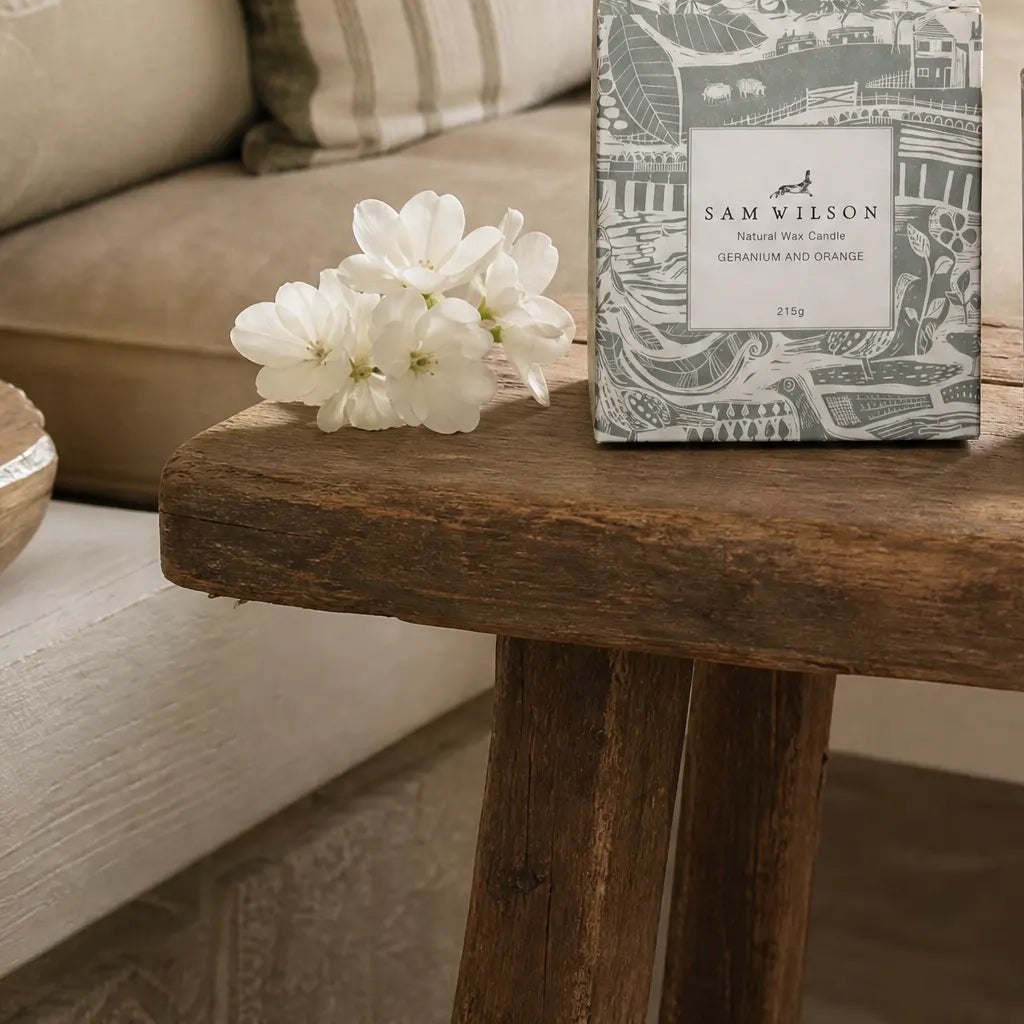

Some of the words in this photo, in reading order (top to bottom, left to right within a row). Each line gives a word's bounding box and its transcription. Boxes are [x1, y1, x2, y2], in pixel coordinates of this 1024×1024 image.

[704, 206, 758, 221] SAM
[771, 205, 877, 220] WILSON
[737, 231, 777, 241] Natural
[780, 231, 804, 241] Wax
[808, 230, 846, 241] Candle
[717, 252, 781, 262] GERANIUM
[784, 251, 810, 262] AND
[813, 251, 864, 262] ORANGE
[776, 306, 805, 318] 215g
